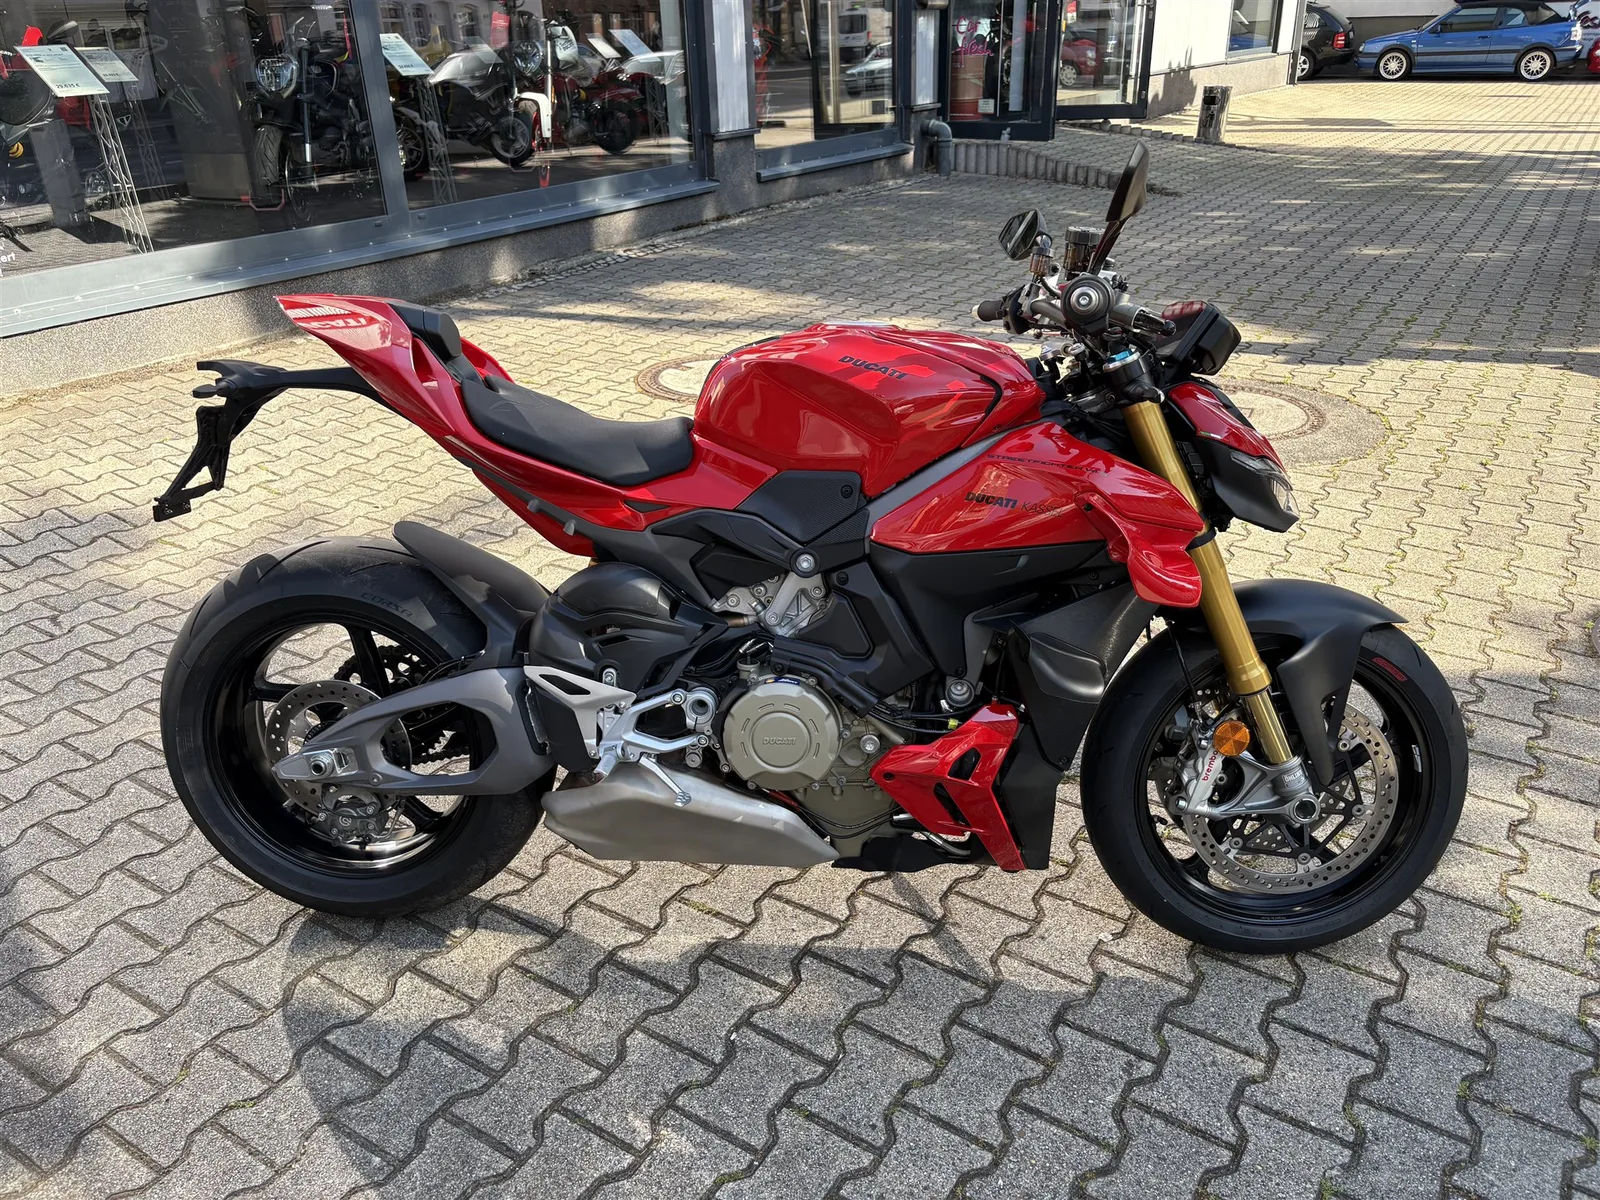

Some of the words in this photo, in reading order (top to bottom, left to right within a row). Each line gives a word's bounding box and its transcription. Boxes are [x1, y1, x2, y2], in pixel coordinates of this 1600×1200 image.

[956, 16, 981, 34] Car
[951, 36, 995, 68] fresh
[838, 355, 907, 380] DUCATI
[987, 453, 1083, 471] STREETFIGHTER
[965, 491, 1018, 509] DUCATI
[1021, 501, 1063, 518] KASSEL
[360, 592, 413, 618] CORSA
[763, 737, 796, 746] DUCATI
[1201, 749, 1219, 782] brembo
